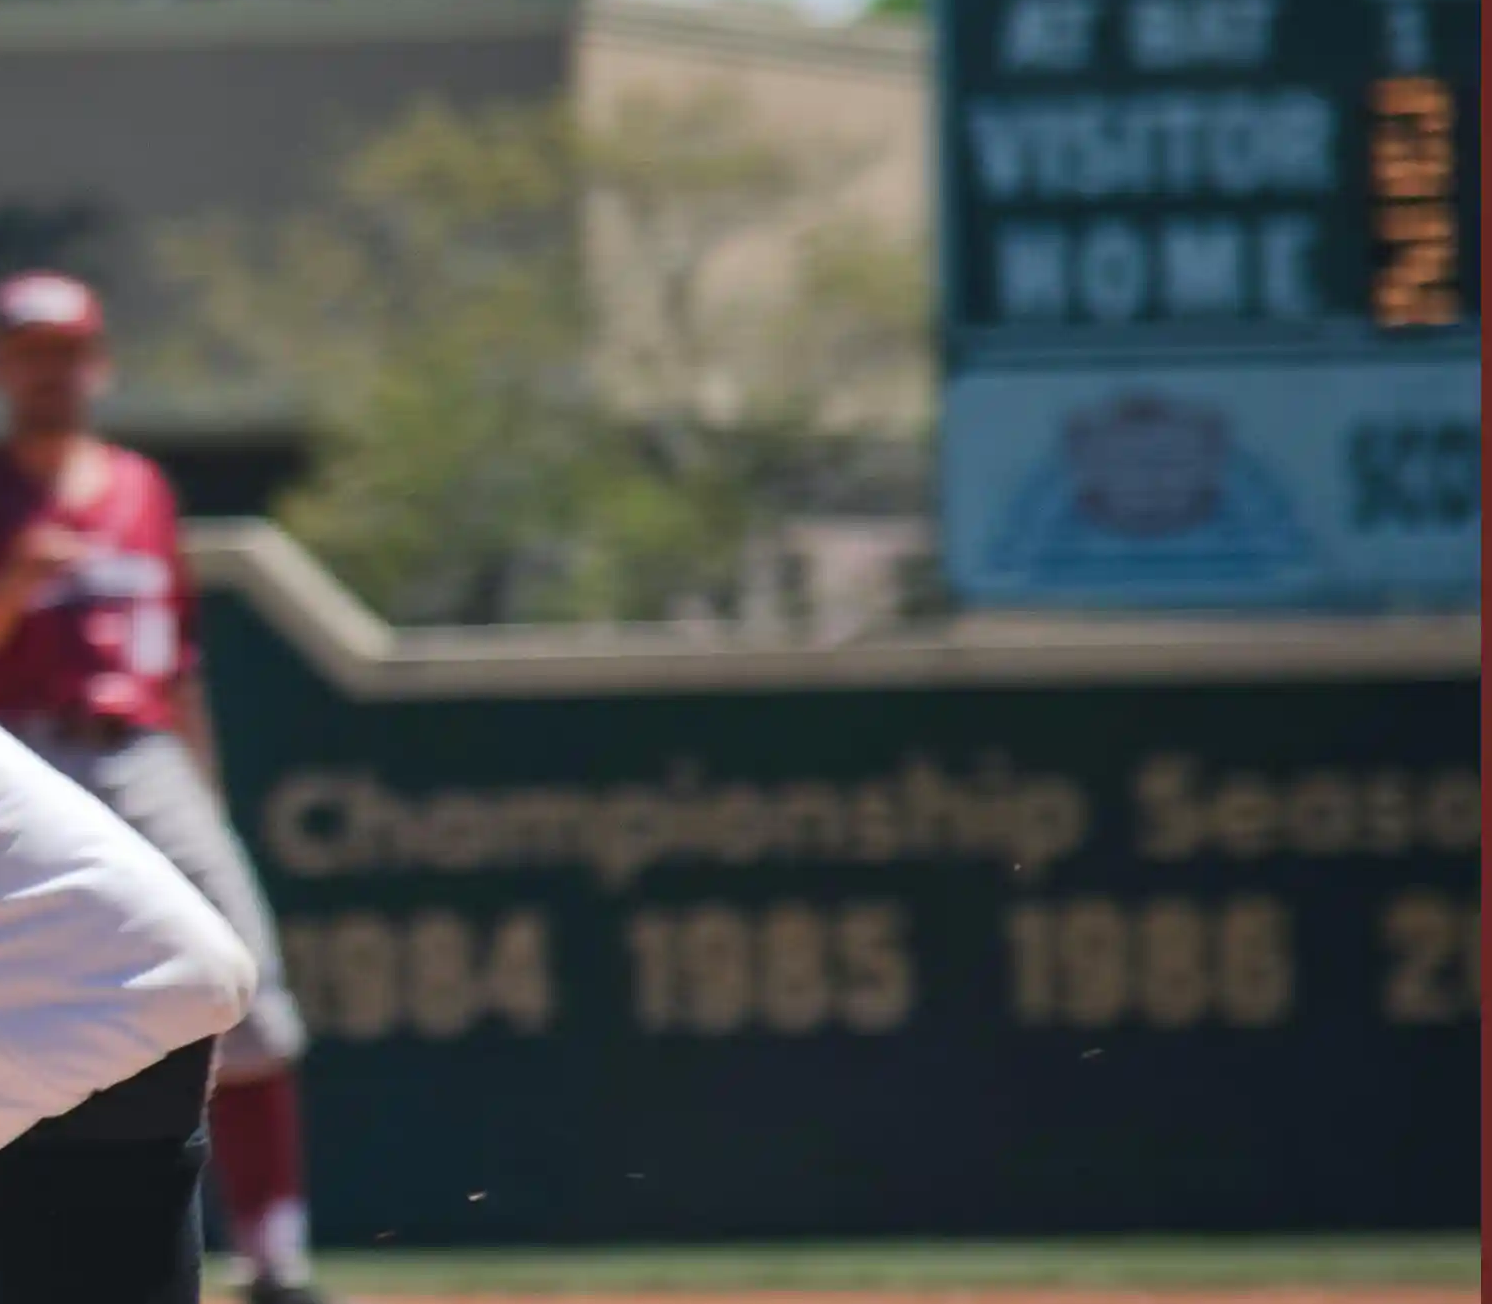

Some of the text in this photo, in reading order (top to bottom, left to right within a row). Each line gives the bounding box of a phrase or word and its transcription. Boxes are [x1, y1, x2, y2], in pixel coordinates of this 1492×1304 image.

[967, 93, 1335, 199] VISITOR
[991, 217, 1318, 322] HOME
[261, 750, 1089, 887] Championship
[291, 905, 557, 1041] 1984
[625, 901, 915, 1039] 1985
[1005, 895, 1298, 1033] 1986
